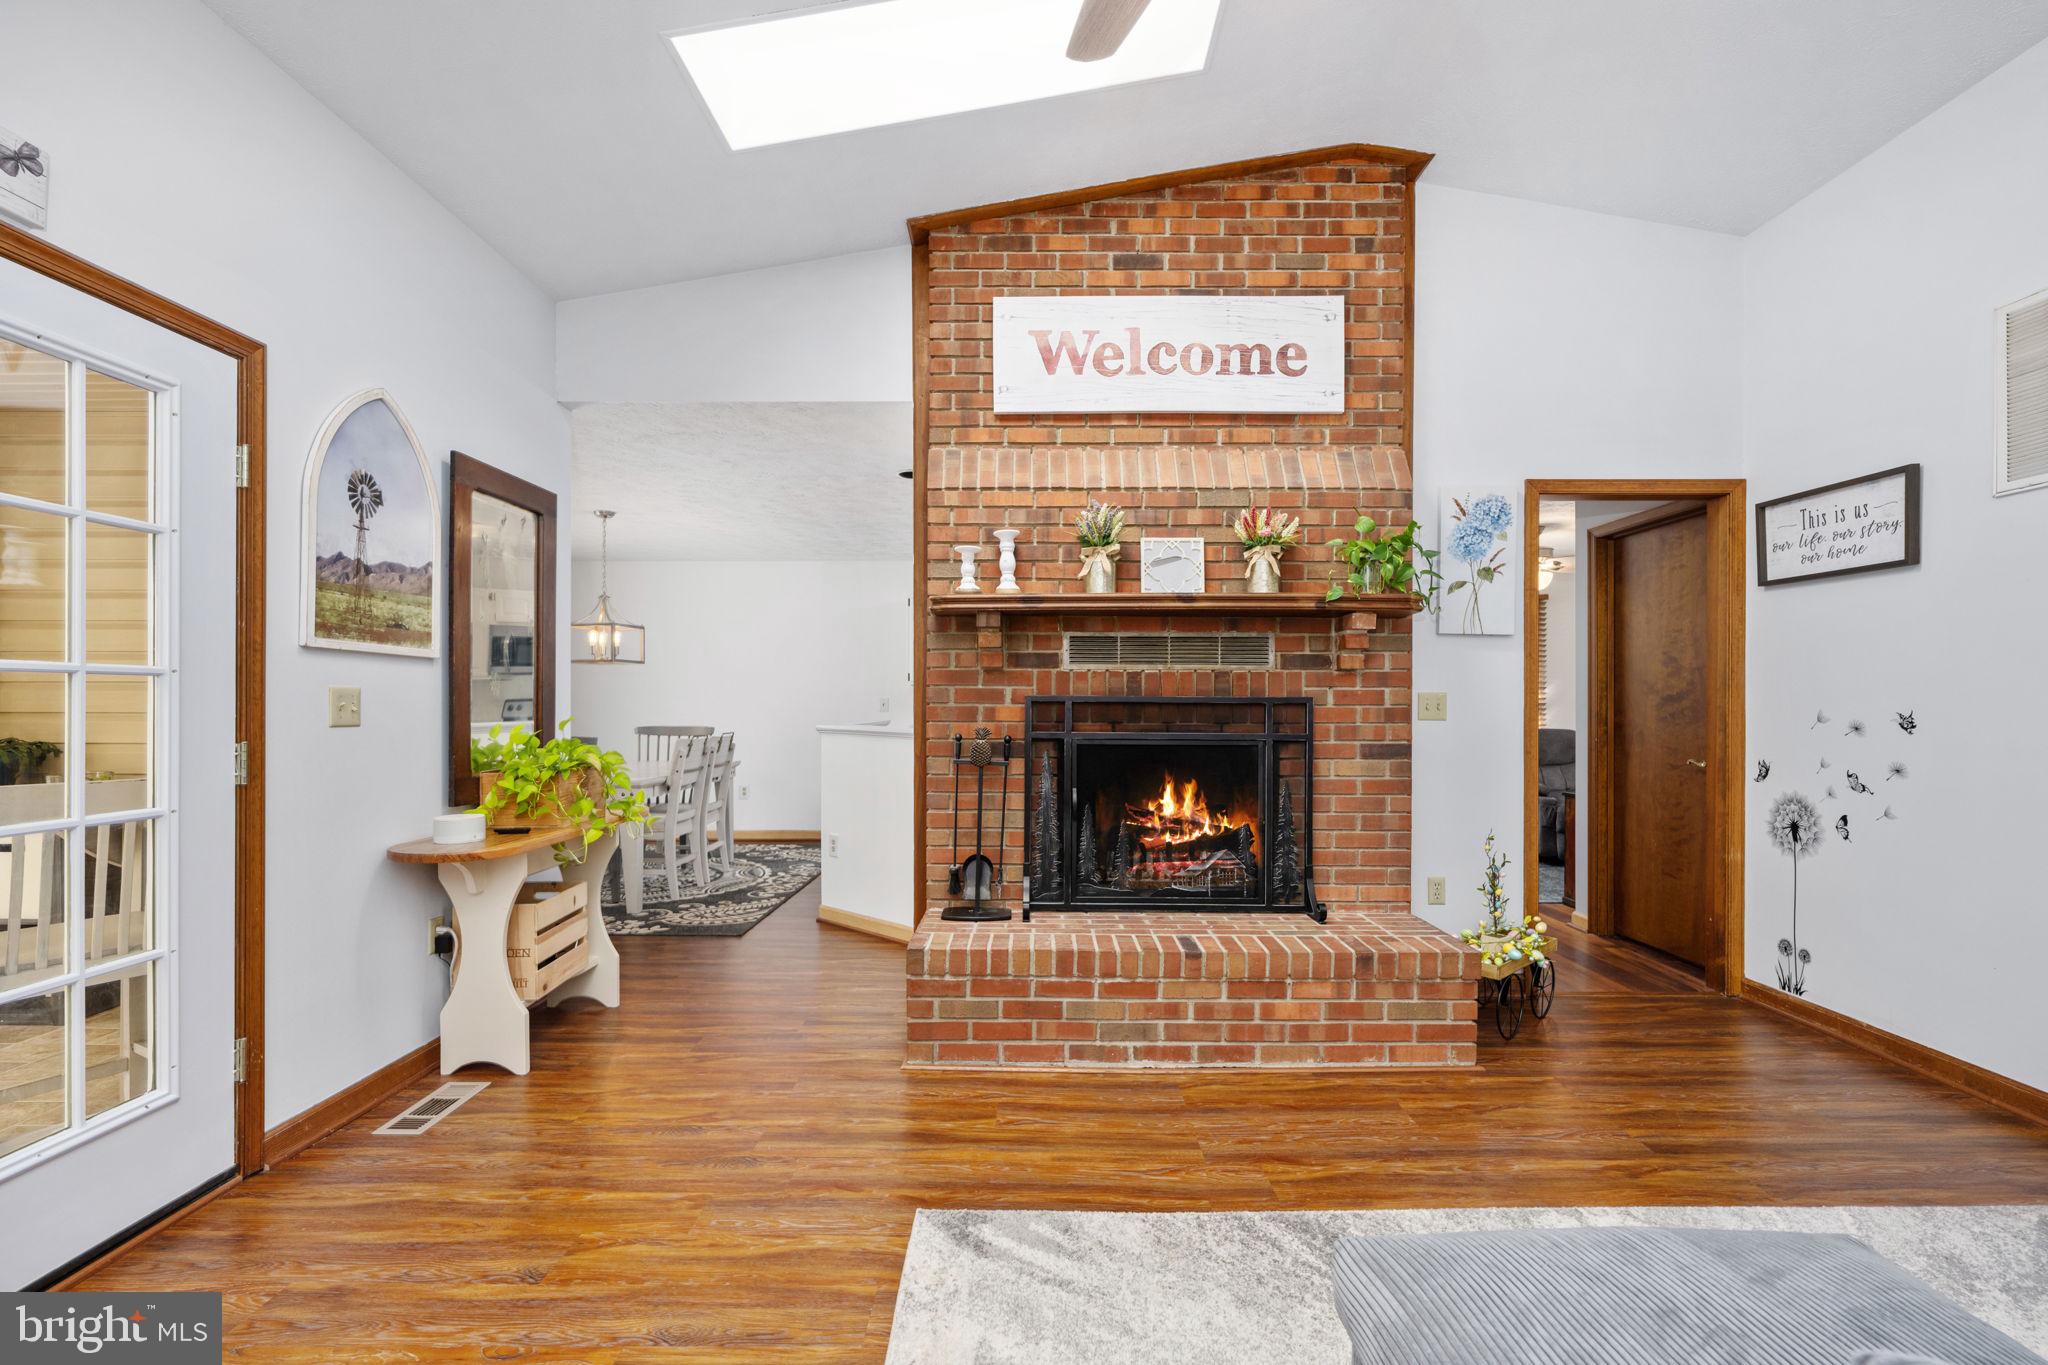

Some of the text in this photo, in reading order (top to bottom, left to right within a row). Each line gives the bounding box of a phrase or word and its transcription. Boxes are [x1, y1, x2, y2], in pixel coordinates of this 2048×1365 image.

[1028, 327, 1308, 377] Welcome
[1800, 503, 1869, 530] This is us
[1772, 540, 1793, 553] our
[1832, 528, 1856, 542] our
[1800, 543, 1868, 565] our home
